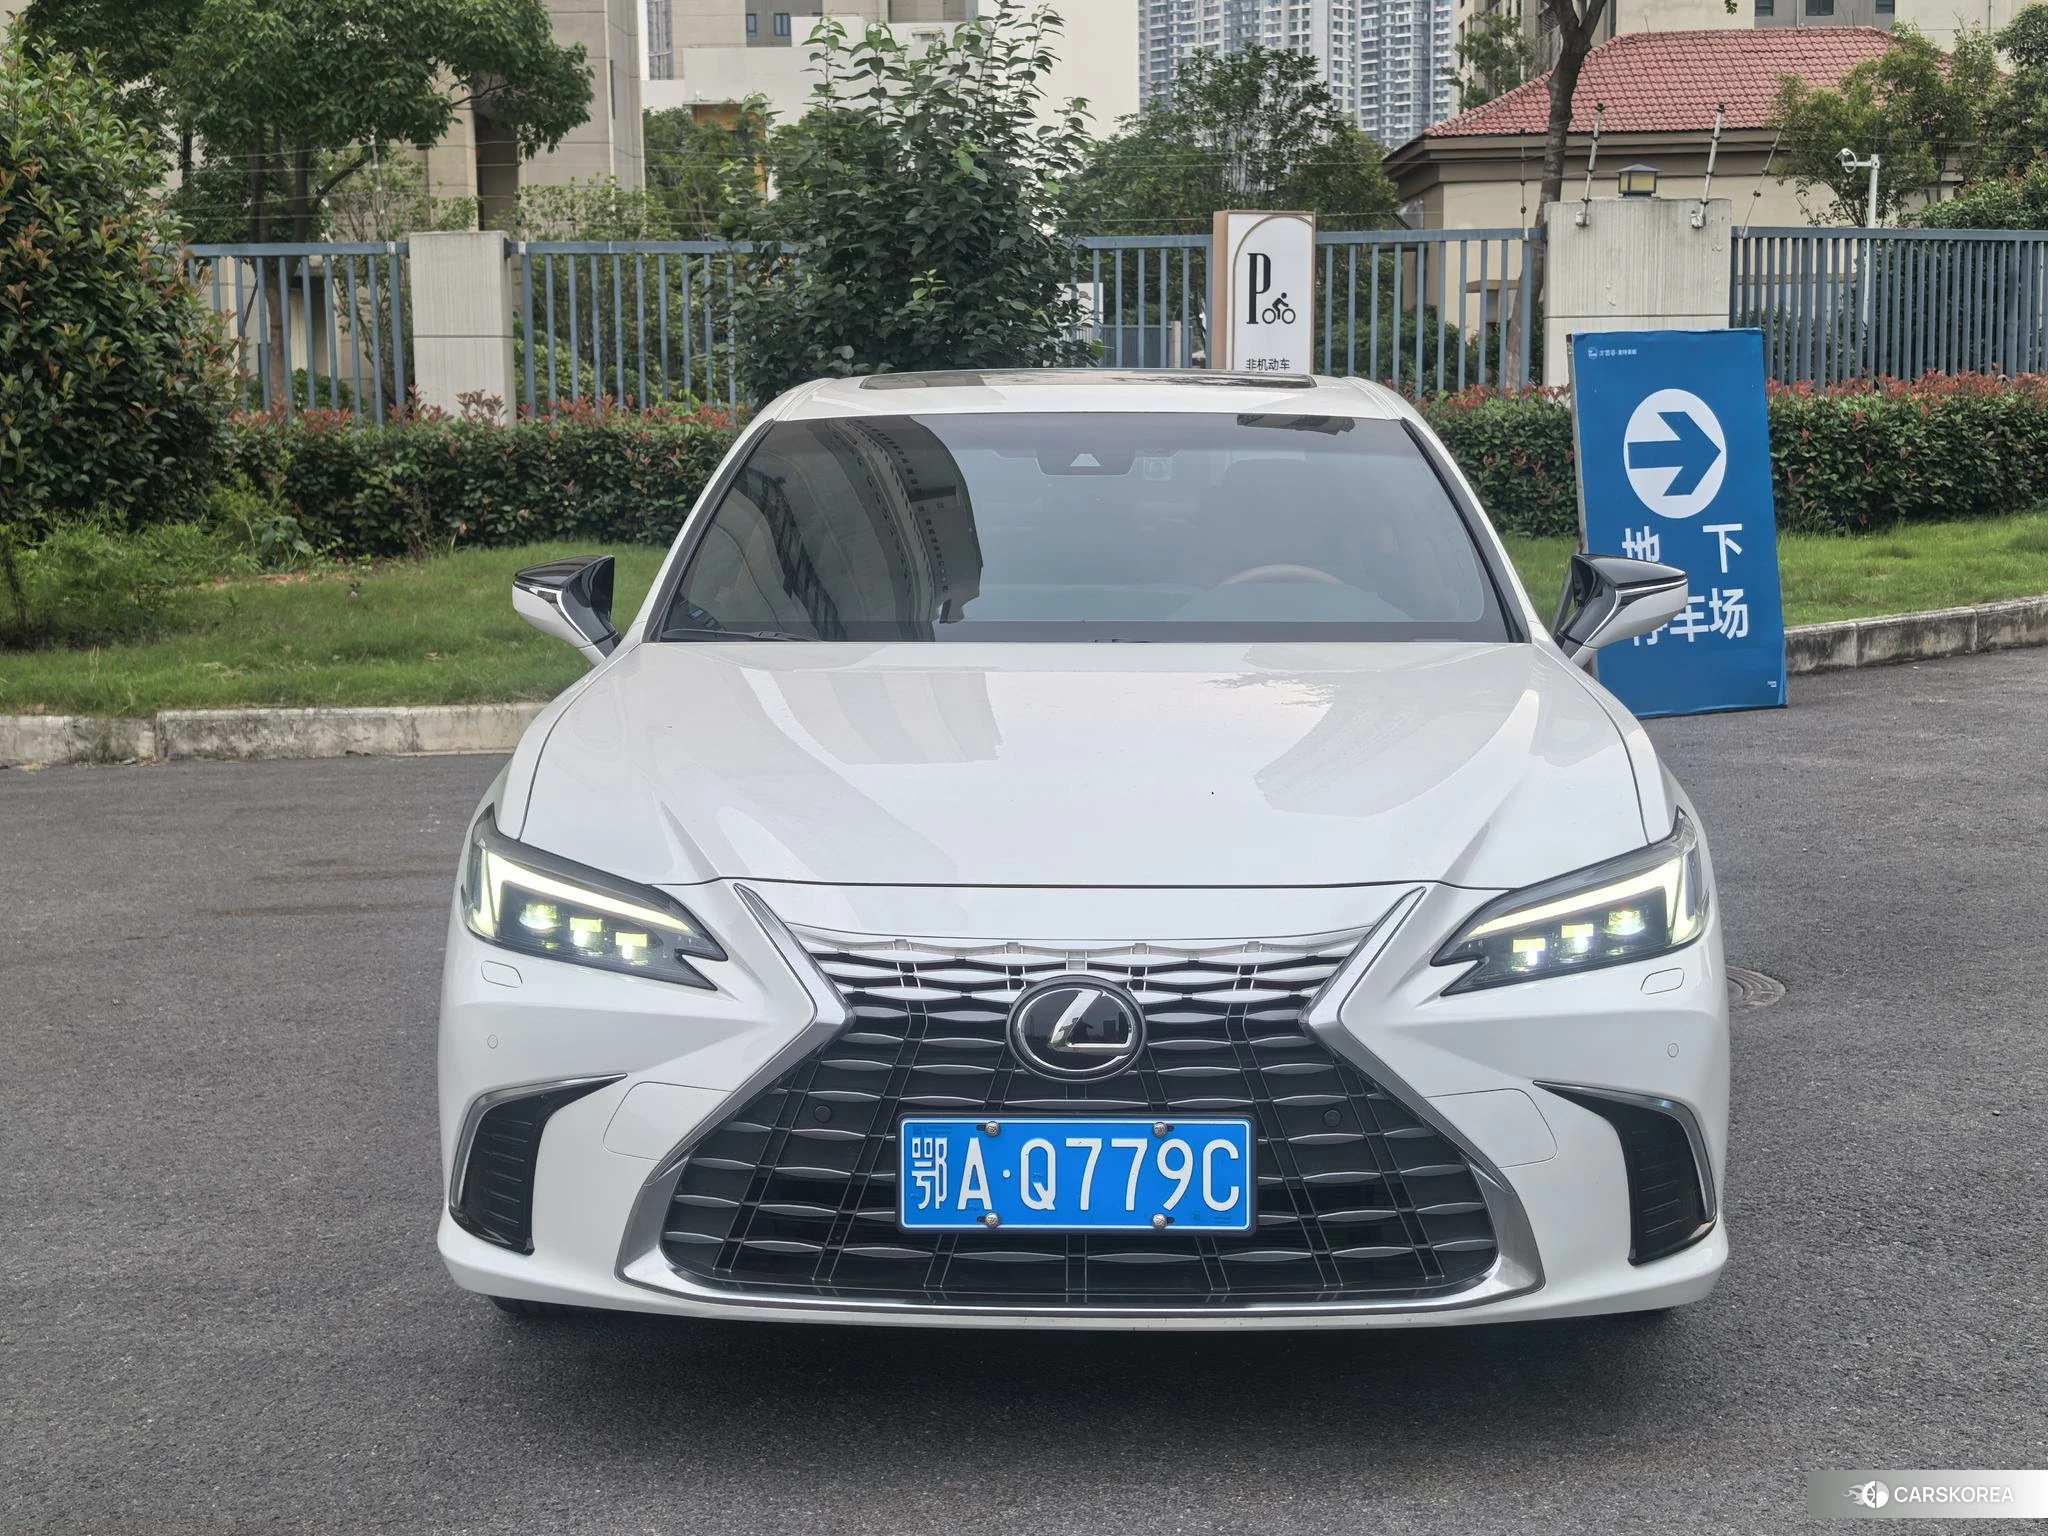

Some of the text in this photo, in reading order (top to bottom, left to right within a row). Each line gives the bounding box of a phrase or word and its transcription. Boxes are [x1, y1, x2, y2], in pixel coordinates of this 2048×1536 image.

[1246, 252, 1272, 325] P
[1245, 357, 1291, 371] 非机动车
[1633, 587, 1748, 646] 车场
